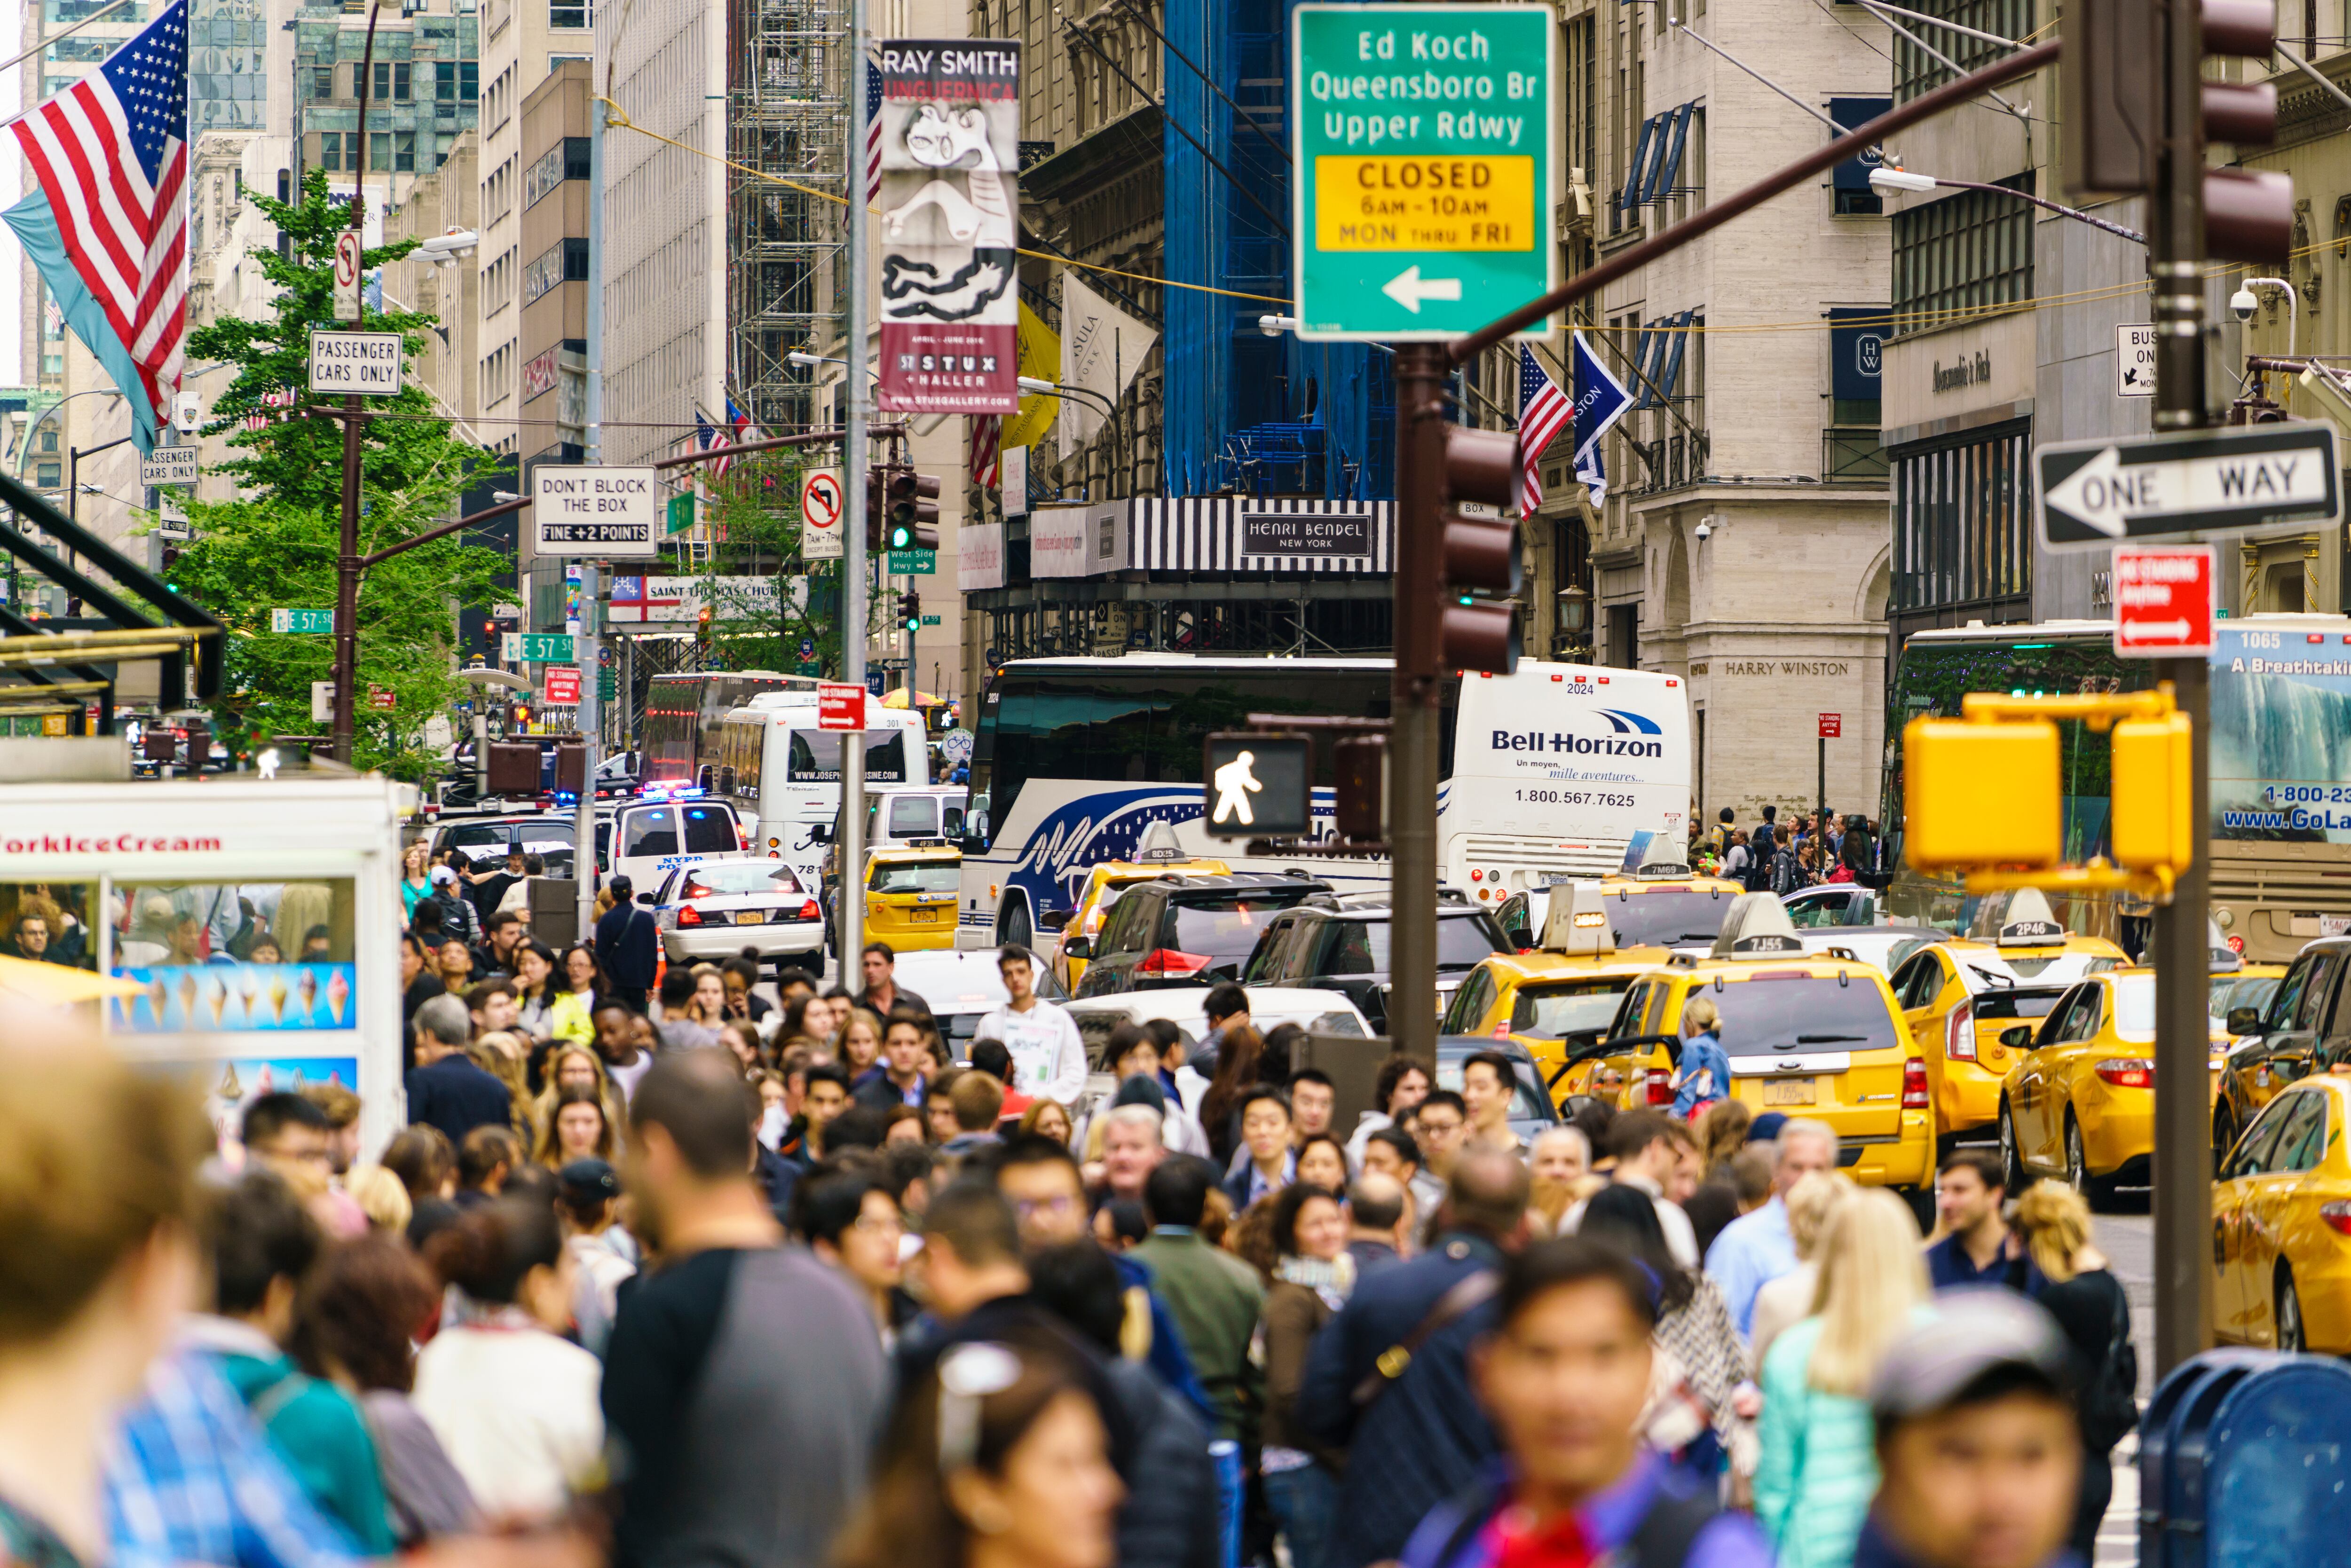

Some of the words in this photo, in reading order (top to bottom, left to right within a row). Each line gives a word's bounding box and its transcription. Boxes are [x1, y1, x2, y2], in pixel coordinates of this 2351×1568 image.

[1358, 31, 1395, 61] Ed
[1412, 31, 1489, 63] Koch
[884, 50, 934, 74] RAY
[941, 50, 1017, 76] SMITH
[884, 80, 1015, 103] UNGUERNICA
[1310, 71, 1494, 101] Queensboro
[1507, 71, 1537, 99] Br
[1324, 111, 1420, 146] Upper
[1437, 110, 1523, 147] Rdwy
[1358, 163, 1490, 189] CLOSED
[1339, 223, 1397, 243] MON
[1411, 229, 1459, 243] THRU
[1471, 223, 1511, 243] FRI
[1073, 315, 1098, 357] SULA
[2132, 331, 2157, 344] BUS
[317, 340, 394, 359] PASSENGER
[2137, 350, 2154, 363] ON
[316, 364, 350, 381] CARS
[361, 365, 394, 382] ONLY
[1077, 350, 1099, 382] YORK
[919, 375, 986, 387] HALLER
[1009, 398, 1042, 447] RESTAURANT
[144, 468, 166, 479] CARS
[173, 466, 194, 478] ONLY
[543, 480, 587, 493] DON'T
[595, 480, 646, 493] BLOCK
[2082, 469, 2160, 513] ONE
[2218, 459, 2298, 498] WAY
[562, 498, 591, 512] THE
[598, 498, 627, 512] BOX
[1466, 504, 1484, 512] BOX
[543, 526, 572, 540] FINE
[575, 526, 597, 540] +2
[600, 526, 647, 540] POINTS
[1250, 523, 1296, 536] HENRI
[1306, 523, 1363, 536] BENDEL
[651, 586, 684, 596] SAINT
[744, 586, 797, 596] CHURH
[1112, 604, 1138, 612] BUS
[289, 611, 295, 629] E
[302, 613, 317, 629] 57
[323, 613, 332, 624] St
[2241, 632, 2280, 649] 1065
[521, 638, 529, 657] E
[537, 638, 555, 658] 57
[562, 639, 572, 651] St
[1726, 662, 1776, 675] HARRY
[1781, 662, 1848, 676] WINSTON
[2231, 657, 2245, 672] A
[556, 671, 578, 680] STANDING
[550, 681, 575, 690] ANYTIME
[1567, 683, 1594, 695] 2024
[820, 688, 828, 697] NO
[829, 688, 860, 698] STANDING
[988, 693, 999, 703] 2024
[820, 699, 846, 709] Anytime
[1531, 760, 1561, 769] moyen,
[1549, 768, 1578, 779] mille
[1581, 772, 1644, 783] aventures...
[1515, 789, 1635, 807] 1.800.567.7625
[1652, 866, 1676, 875] 7M69
[2017, 922, 2046, 936] 2P46
[1751, 937, 1783, 951] 7J55
